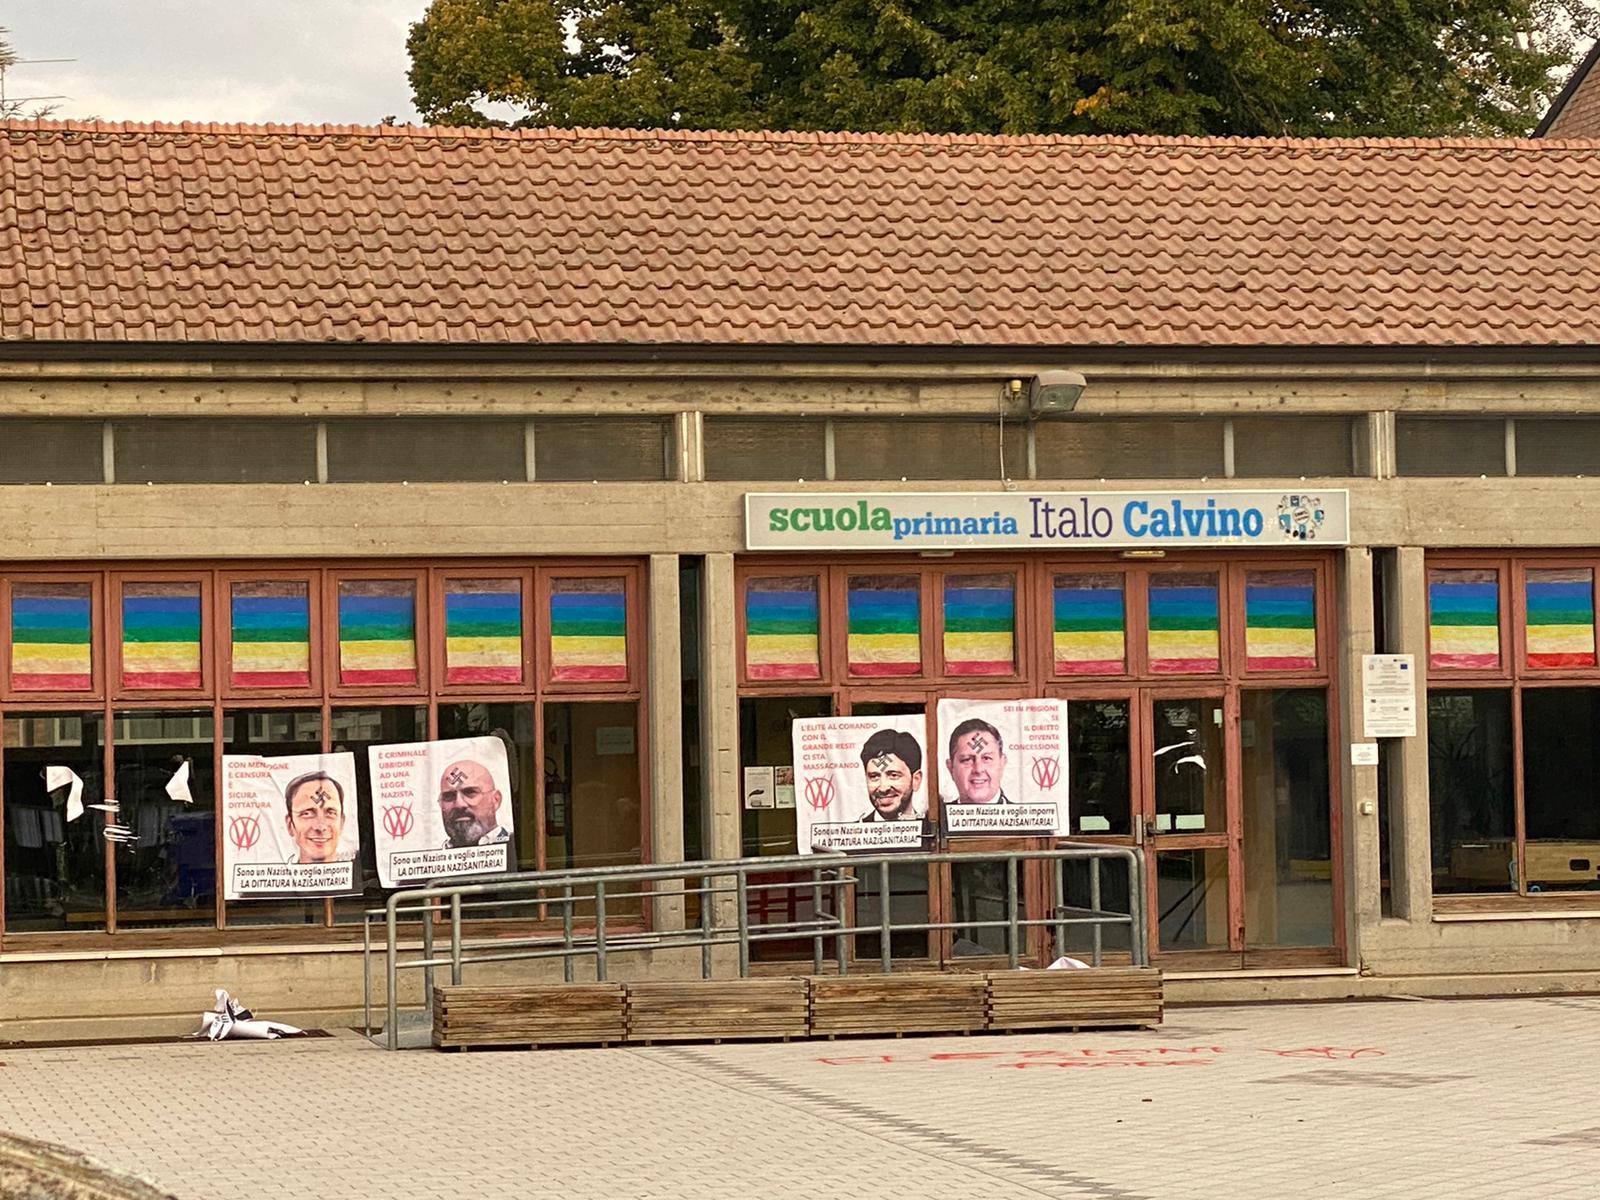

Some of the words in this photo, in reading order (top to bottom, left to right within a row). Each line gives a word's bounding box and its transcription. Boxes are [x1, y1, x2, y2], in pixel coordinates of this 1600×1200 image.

[768, 501, 892, 532] scuola
[893, 512, 1017, 540] primaria
[1029, 498, 1113, 538] Italo
[1123, 500, 1263, 538] Calvino
[385, 750, 426, 758] CRIMINALE
[248, 762, 288, 770] MENGNE
[379, 761, 415, 769] UBBIDIRE
[1007, 807, 1027, 817] voglio
[1029, 806, 1054, 816] imporre
[952, 819, 959, 827] LA
[962, 819, 997, 827] DITTATURA
[1000, 818, 1053, 826] NAZISANITARIA!
[870, 825, 890, 835] voglio
[892, 824, 918, 834] imporre
[828, 838, 861, 846] DITTATURA
[393, 856, 410, 865] Sono
[423, 854, 446, 862] Nazista
[454, 851, 475, 861] voglio
[477, 849, 504, 858] imporre
[237, 868, 254, 876] Sono
[300, 867, 321, 878] voglio
[323, 866, 349, 876] imporre
[398, 868, 406, 876] LA
[408, 866, 445, 875] DITTATURA
[447, 859, 502, 871] NAZISANITARIA!
[241, 880, 249, 888] LA
[252, 880, 290, 888] DITTATURA
[292, 877, 348, 887] NAZISANITARIA!
